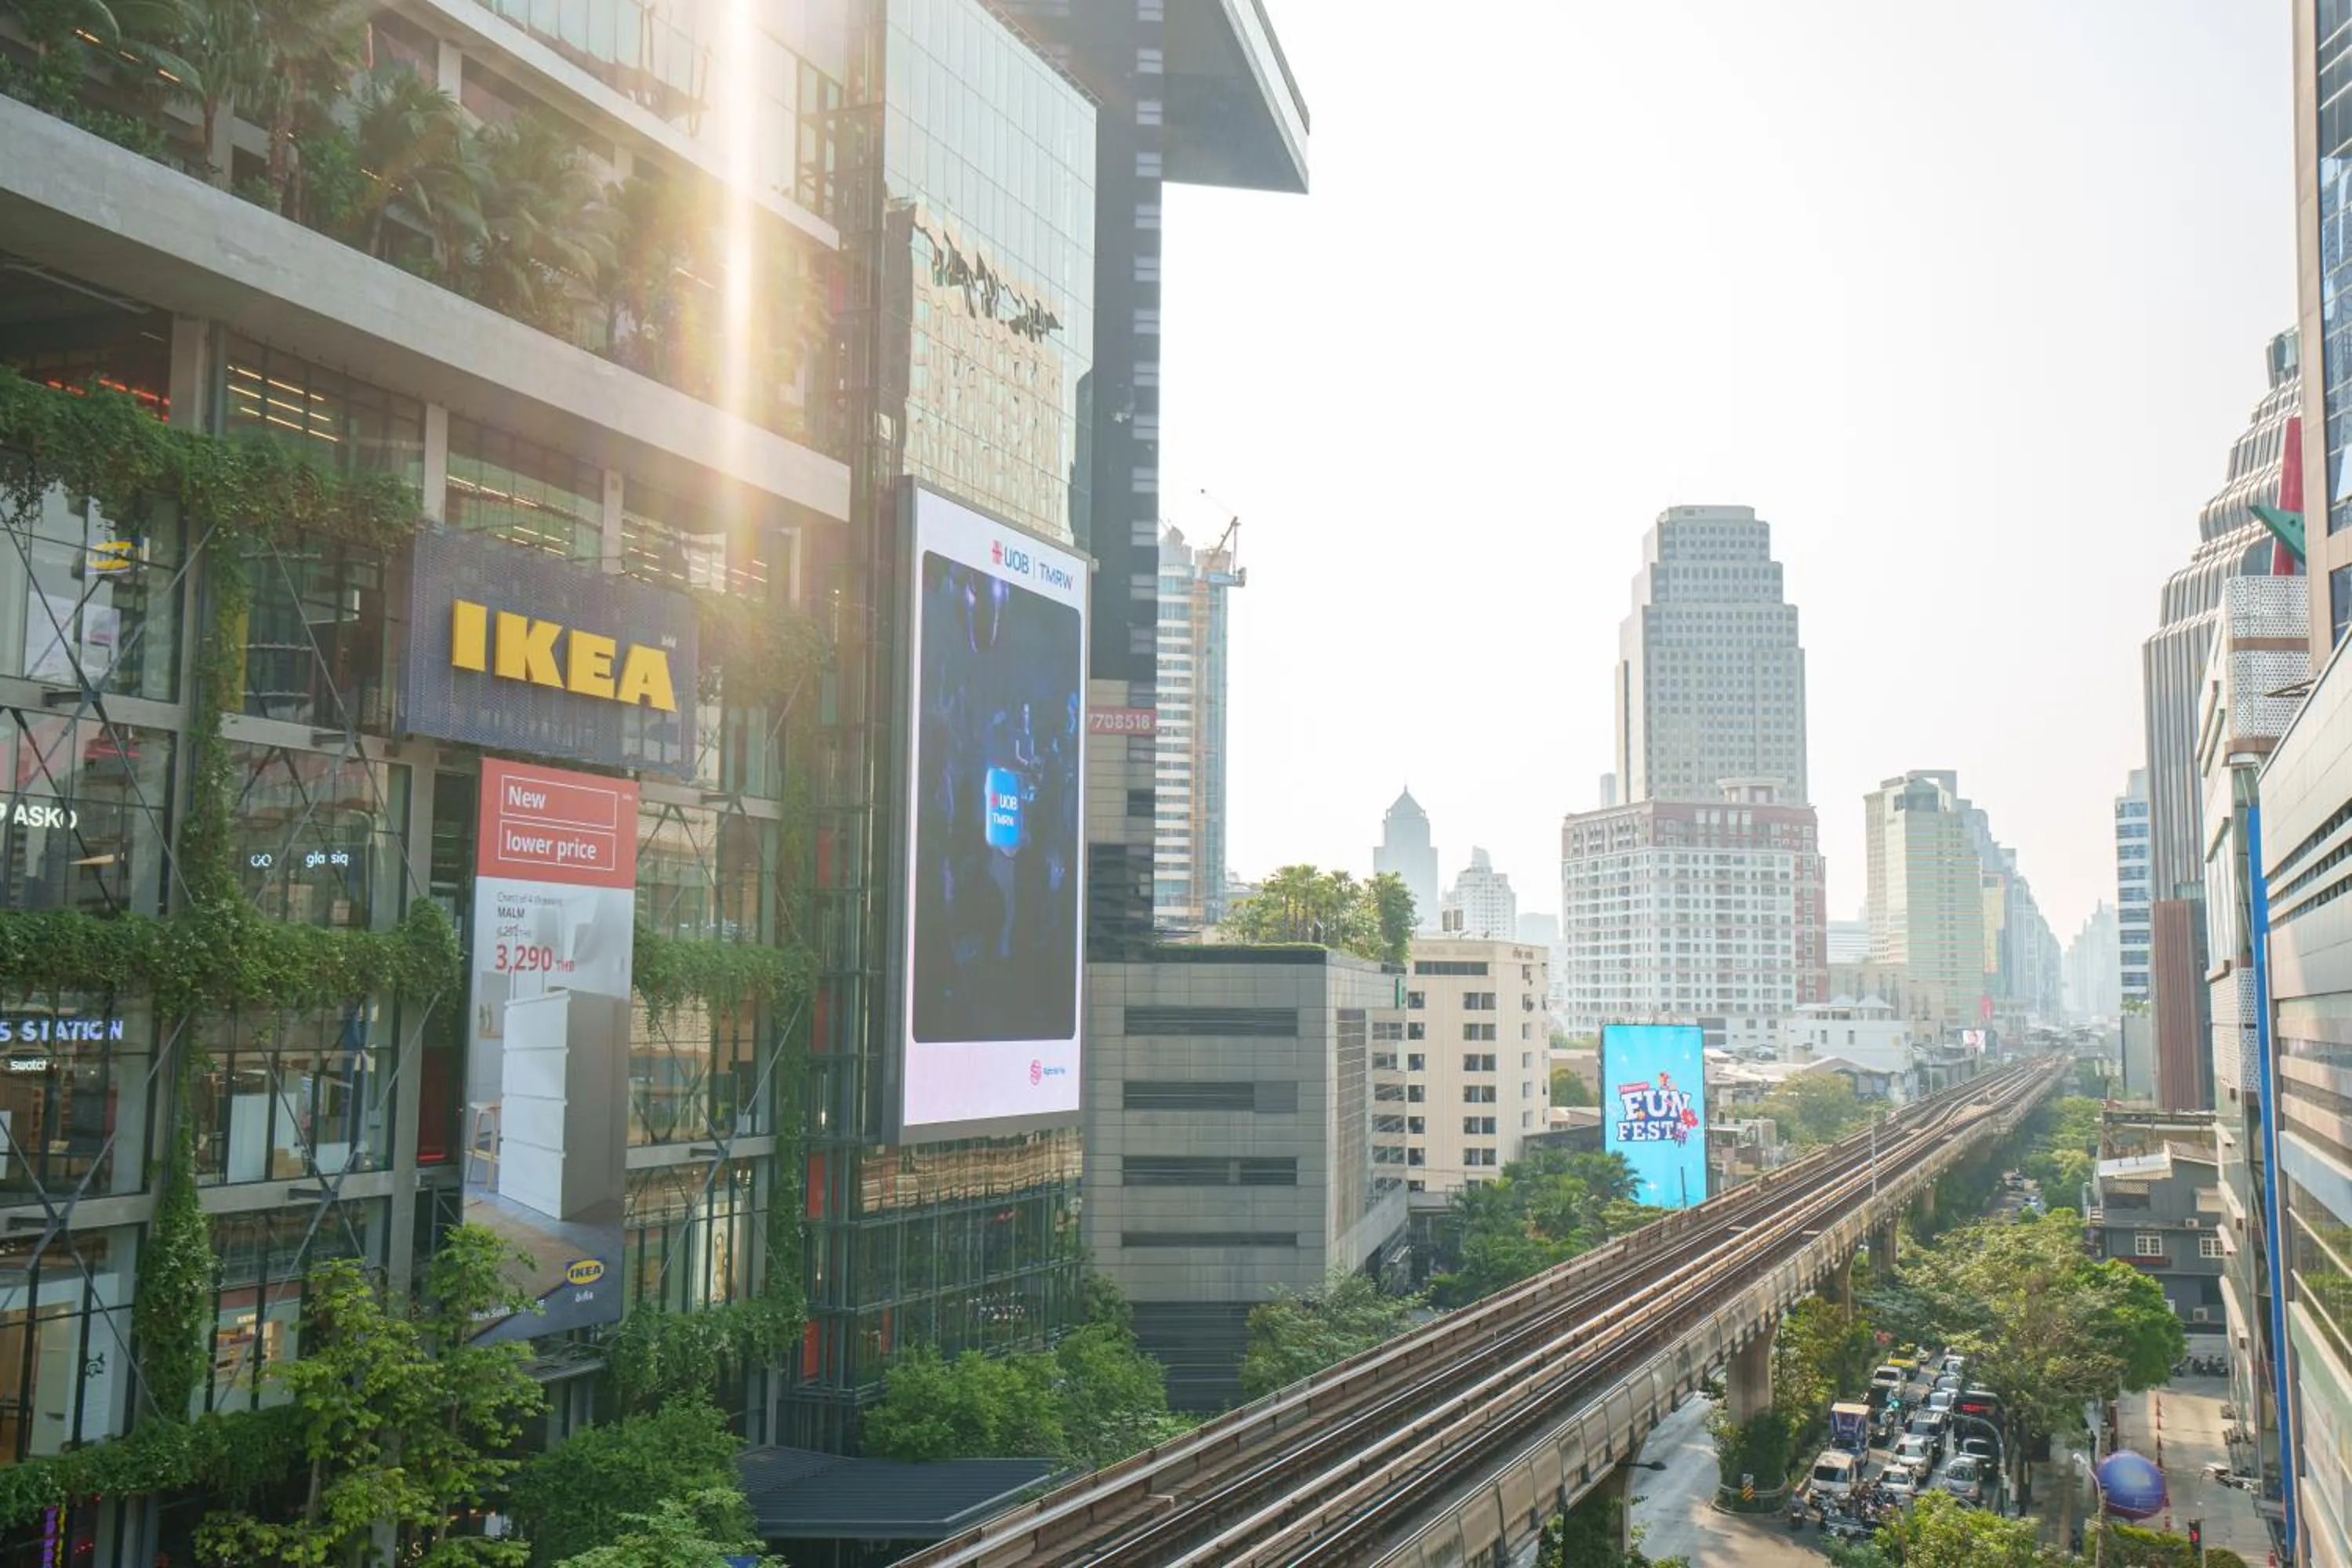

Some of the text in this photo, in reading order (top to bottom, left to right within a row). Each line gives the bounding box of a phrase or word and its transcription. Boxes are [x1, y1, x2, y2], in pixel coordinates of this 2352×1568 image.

[1004, 546, 1073, 590] UOB TMRW
[452, 598, 677, 713] IKEA
[508, 785, 546, 810] New
[506, 829, 597, 864] lower price
[498, 906, 525, 918] MALM
[495, 943, 554, 975] 3,290
[1621, 1089, 1692, 1121] FUN
[1617, 1120, 1675, 1142] FEST
[571, 1265, 604, 1279] IKEA
